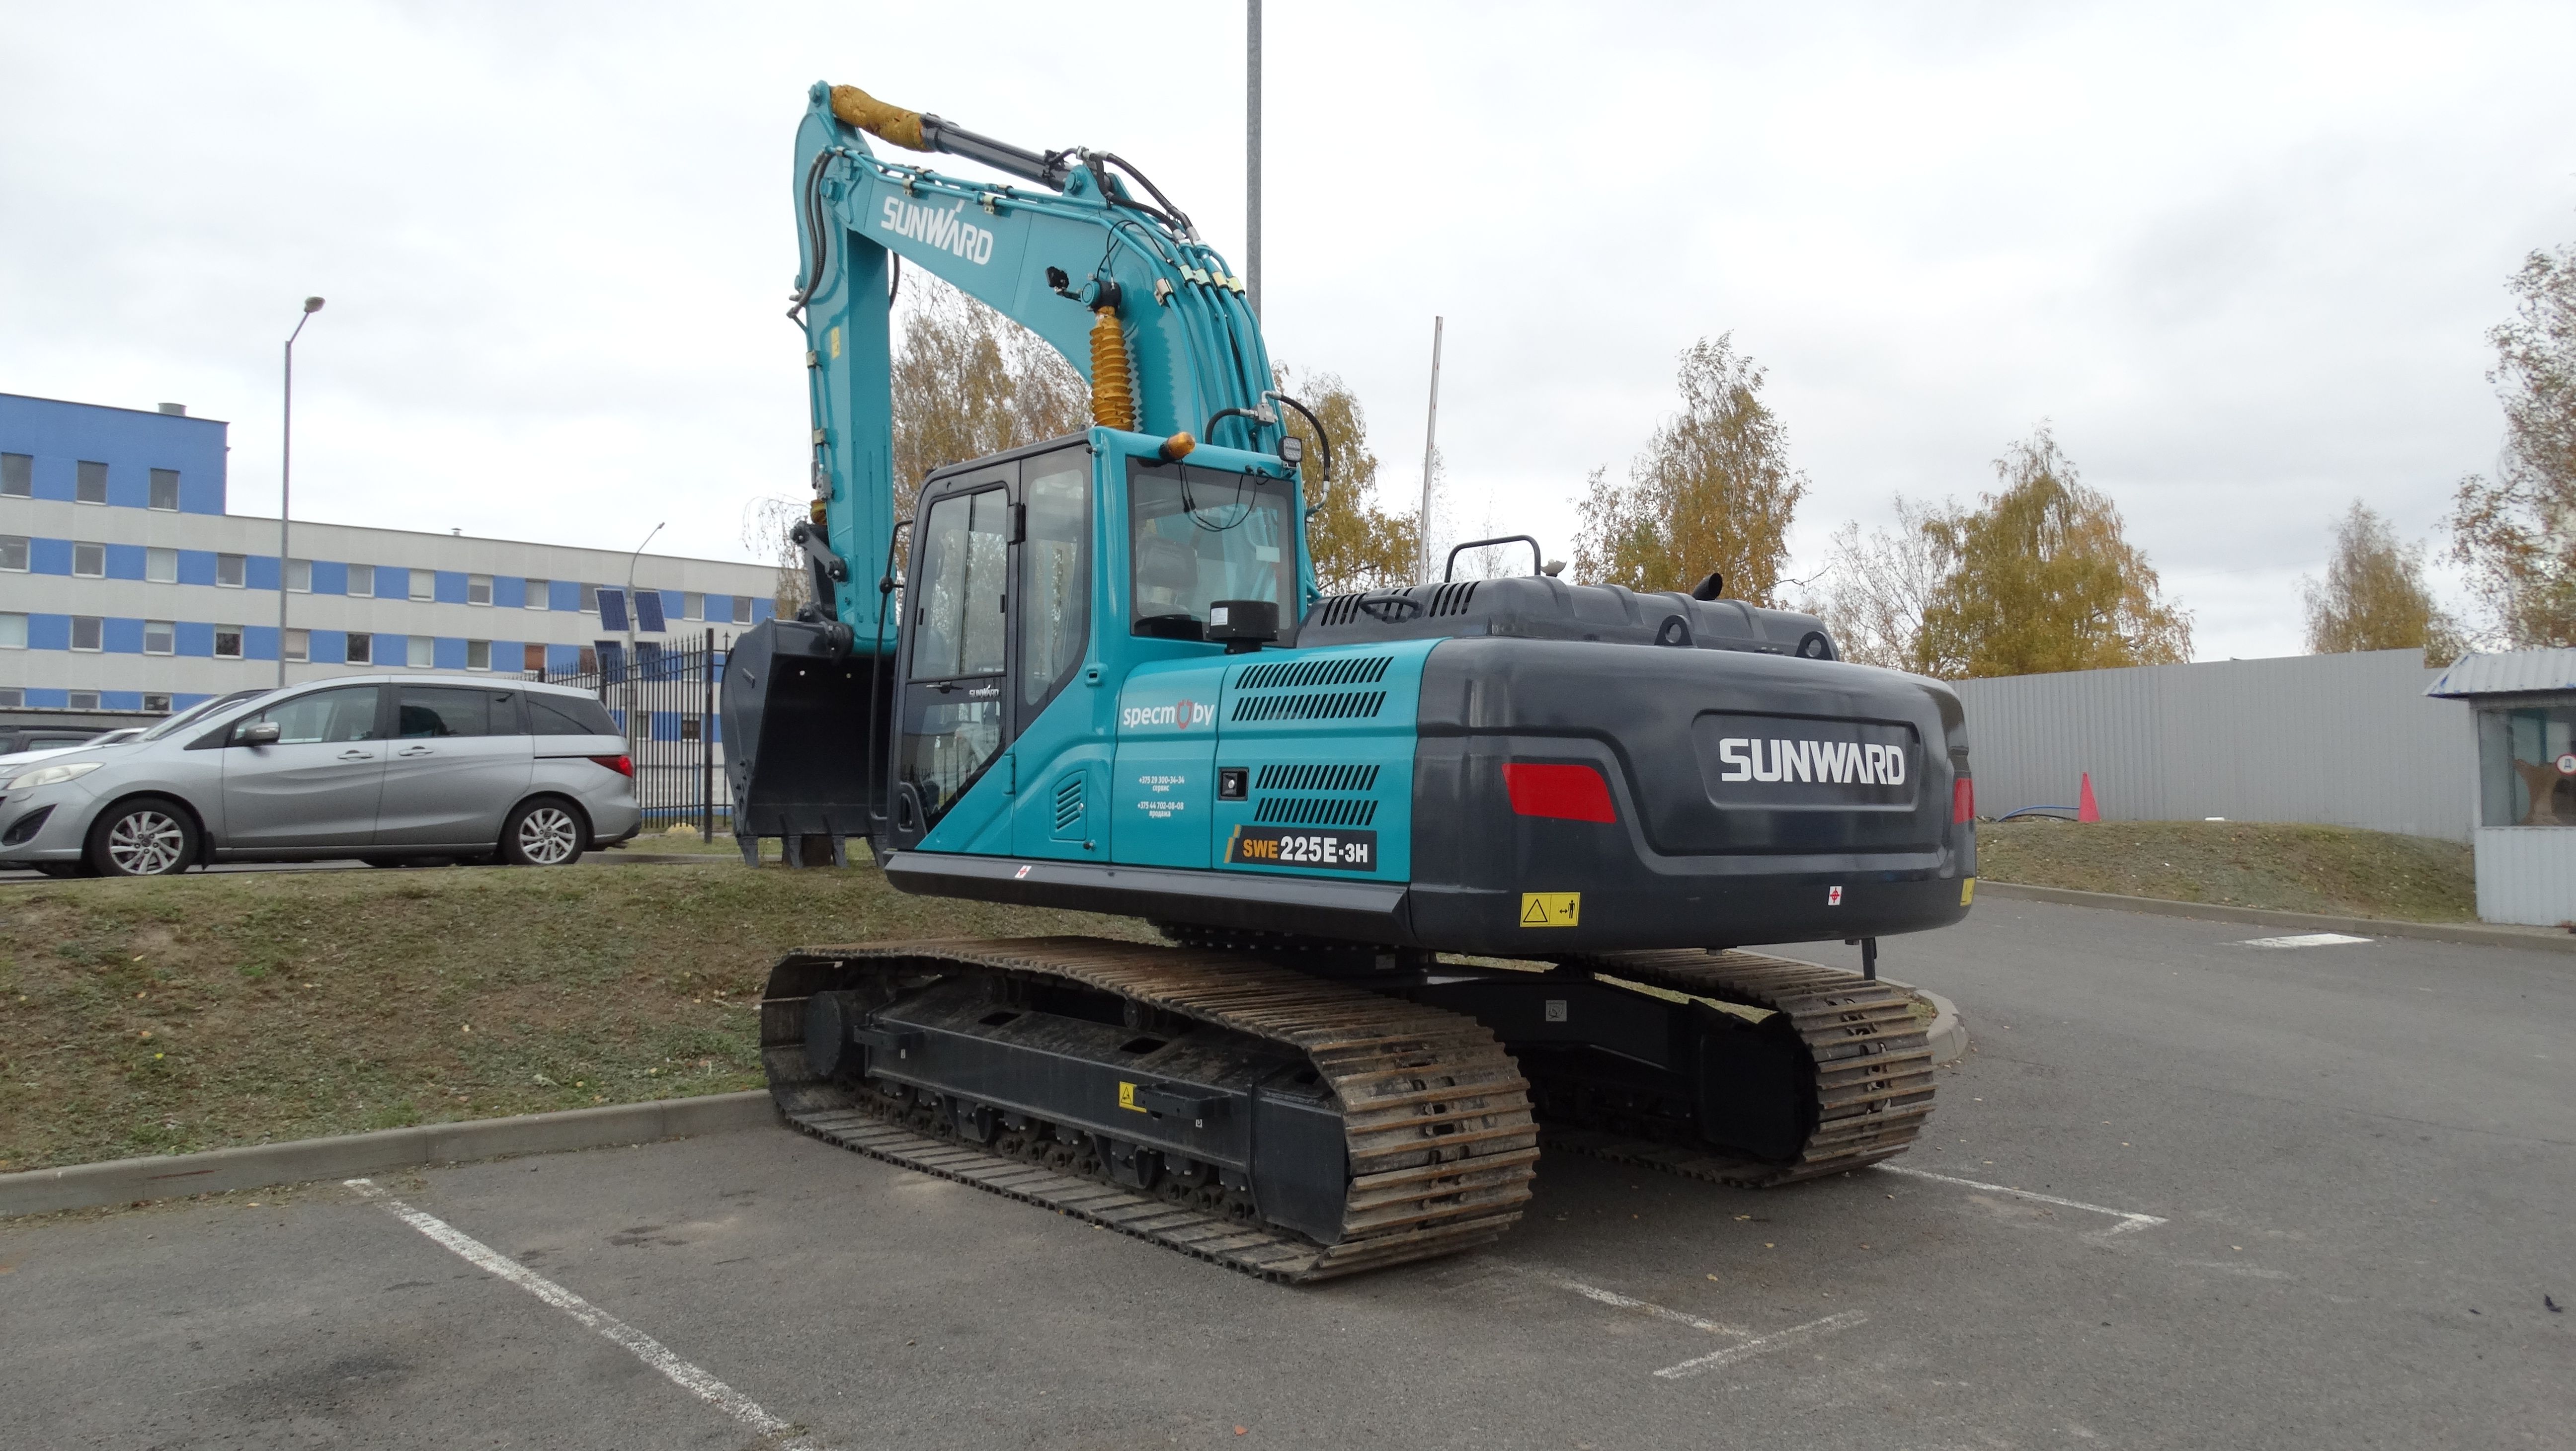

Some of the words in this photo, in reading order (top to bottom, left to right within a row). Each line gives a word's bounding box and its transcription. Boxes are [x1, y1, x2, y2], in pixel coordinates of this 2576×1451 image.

[881, 196, 993, 265] SUNWARD
[969, 684, 999, 698] SUNWARD
[1719, 738, 1905, 785] SUNWARD
